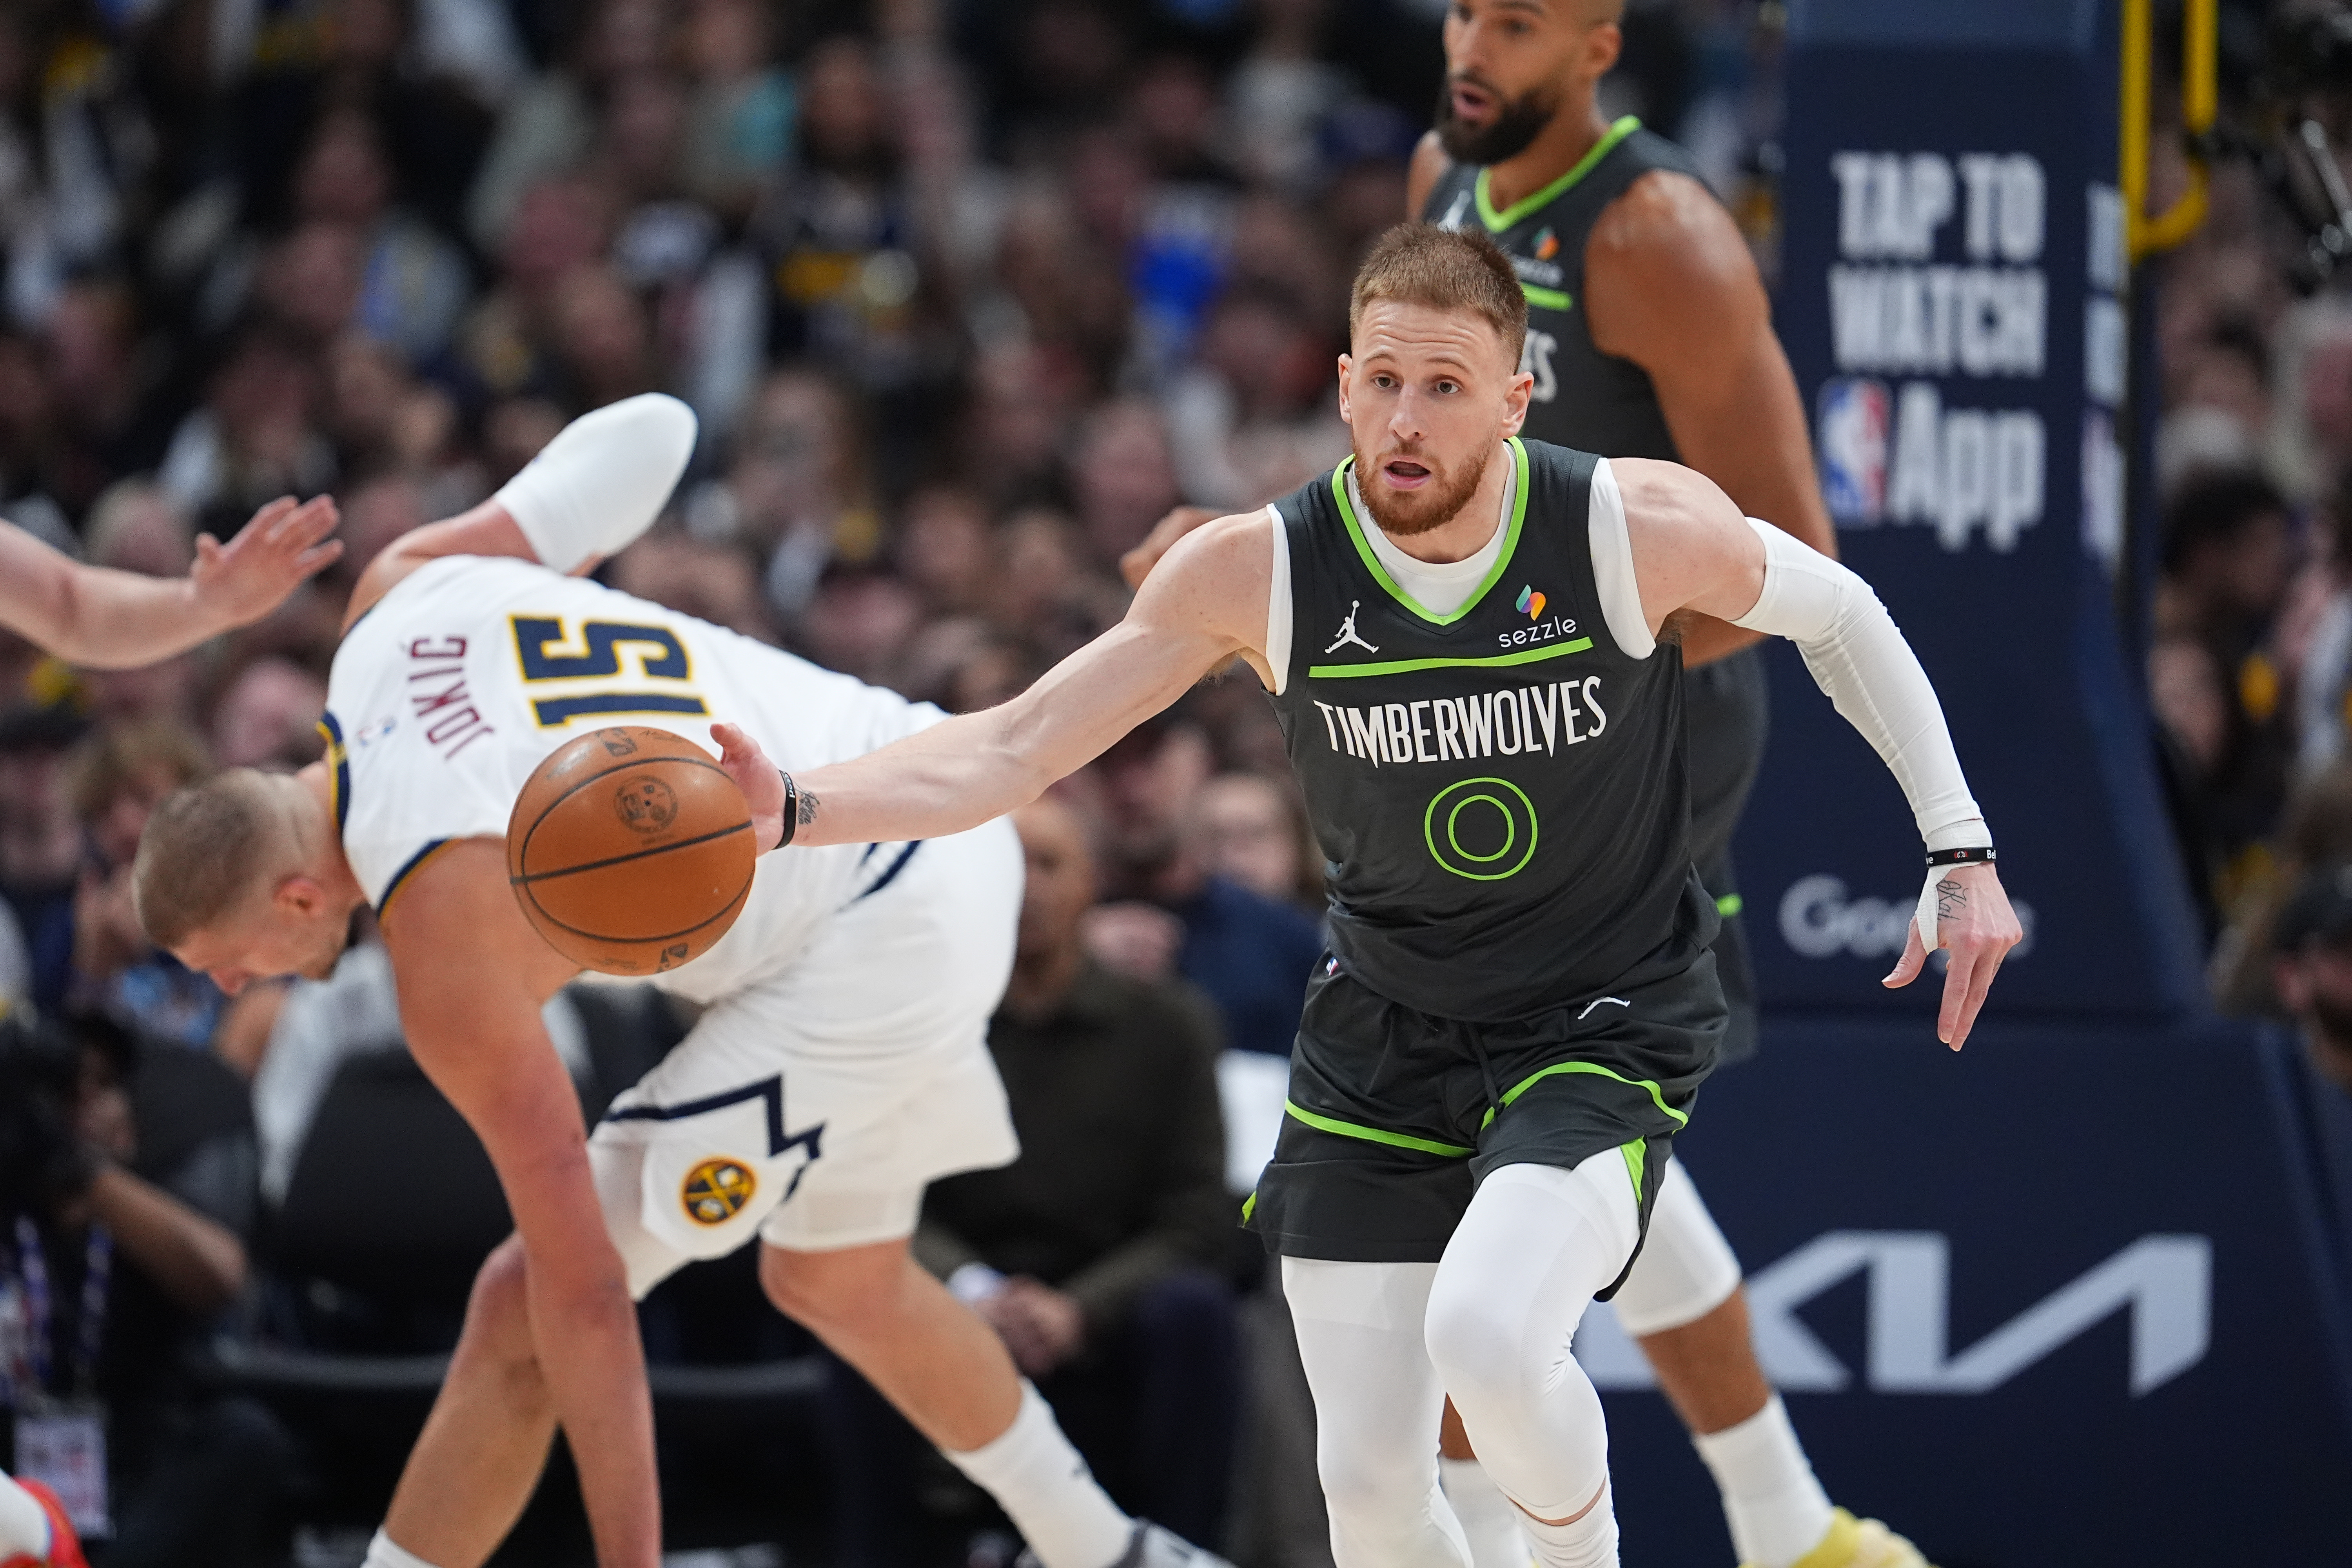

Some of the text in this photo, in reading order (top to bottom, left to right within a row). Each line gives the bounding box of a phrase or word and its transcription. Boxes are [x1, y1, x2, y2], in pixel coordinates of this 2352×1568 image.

[1831, 152, 1955, 260] TAP
[1959, 152, 2046, 261] TO
[1827, 263, 2048, 376] WATCH
[1888, 379, 2046, 551] App
[507, 612, 713, 730] 15
[1498, 616, 1577, 648] sezzle
[1313, 675, 1607, 768] TIMBERWOLVES
[1424, 777, 1538, 880] 0
[1779, 873, 2035, 975] Goo
